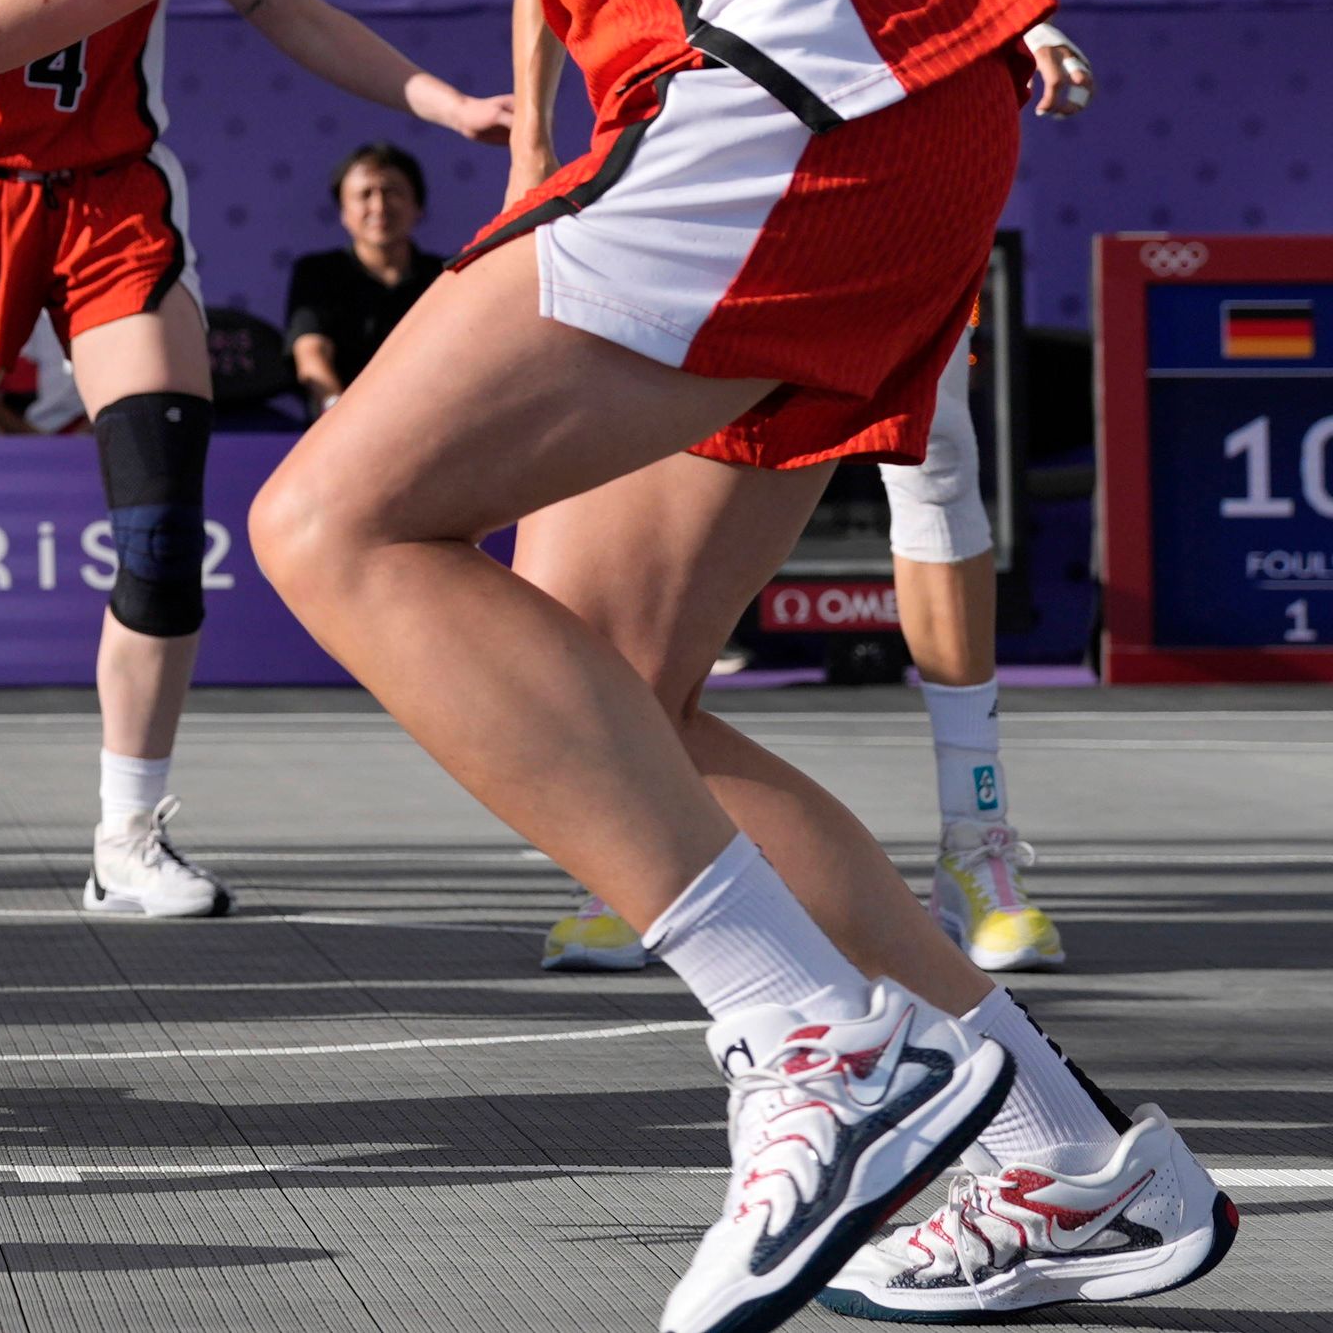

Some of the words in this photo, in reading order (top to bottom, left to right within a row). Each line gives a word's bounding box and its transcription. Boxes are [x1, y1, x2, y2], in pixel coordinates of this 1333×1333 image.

[23, 36, 87, 113] 4
[1245, 549, 1333, 580] FOUL
[817, 588, 900, 624] OME
[1284, 600, 1318, 642] 1
